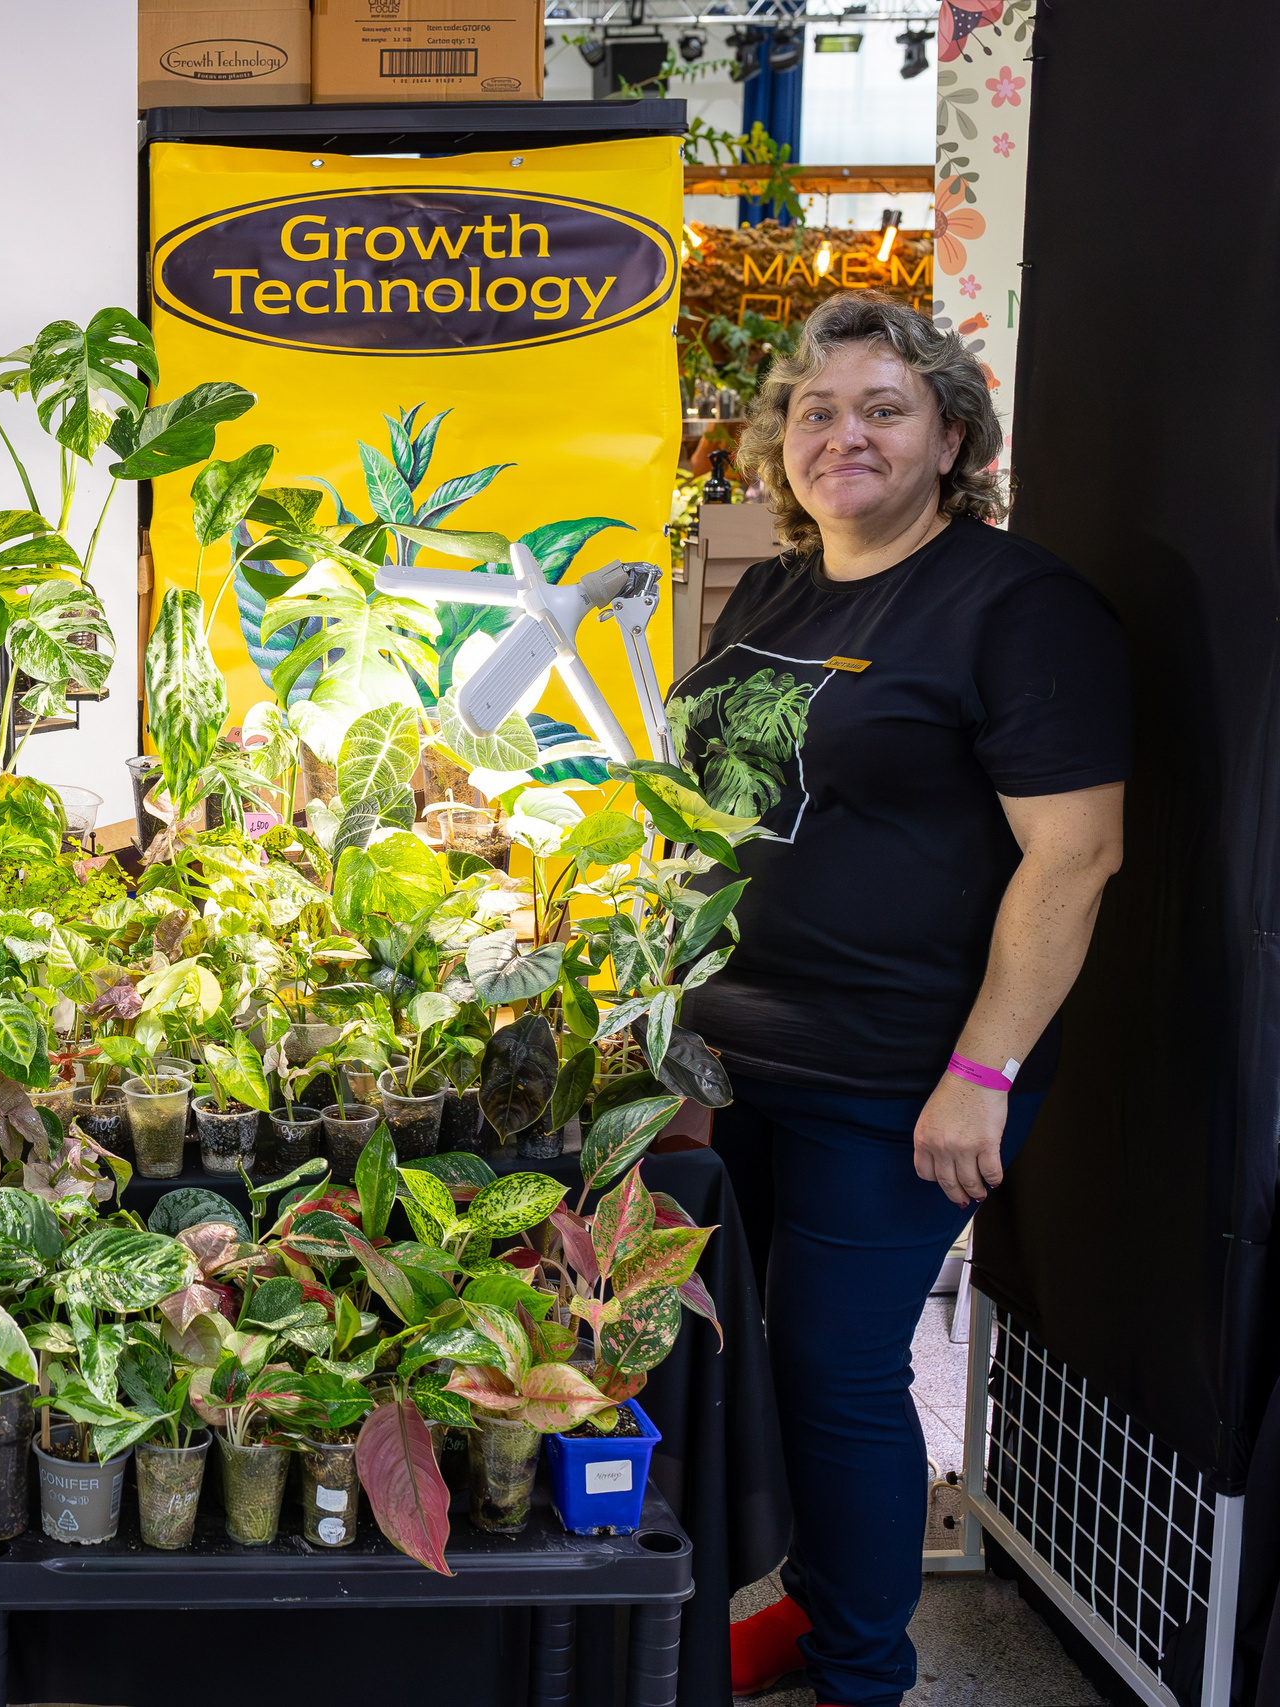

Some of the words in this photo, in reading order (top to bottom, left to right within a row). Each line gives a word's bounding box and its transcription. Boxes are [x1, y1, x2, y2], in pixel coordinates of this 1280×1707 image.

[166, 51, 214, 68] Growth
[214, 50, 281, 70] Technology
[280, 213, 550, 262] Growth
[212, 266, 617, 321] Technology
